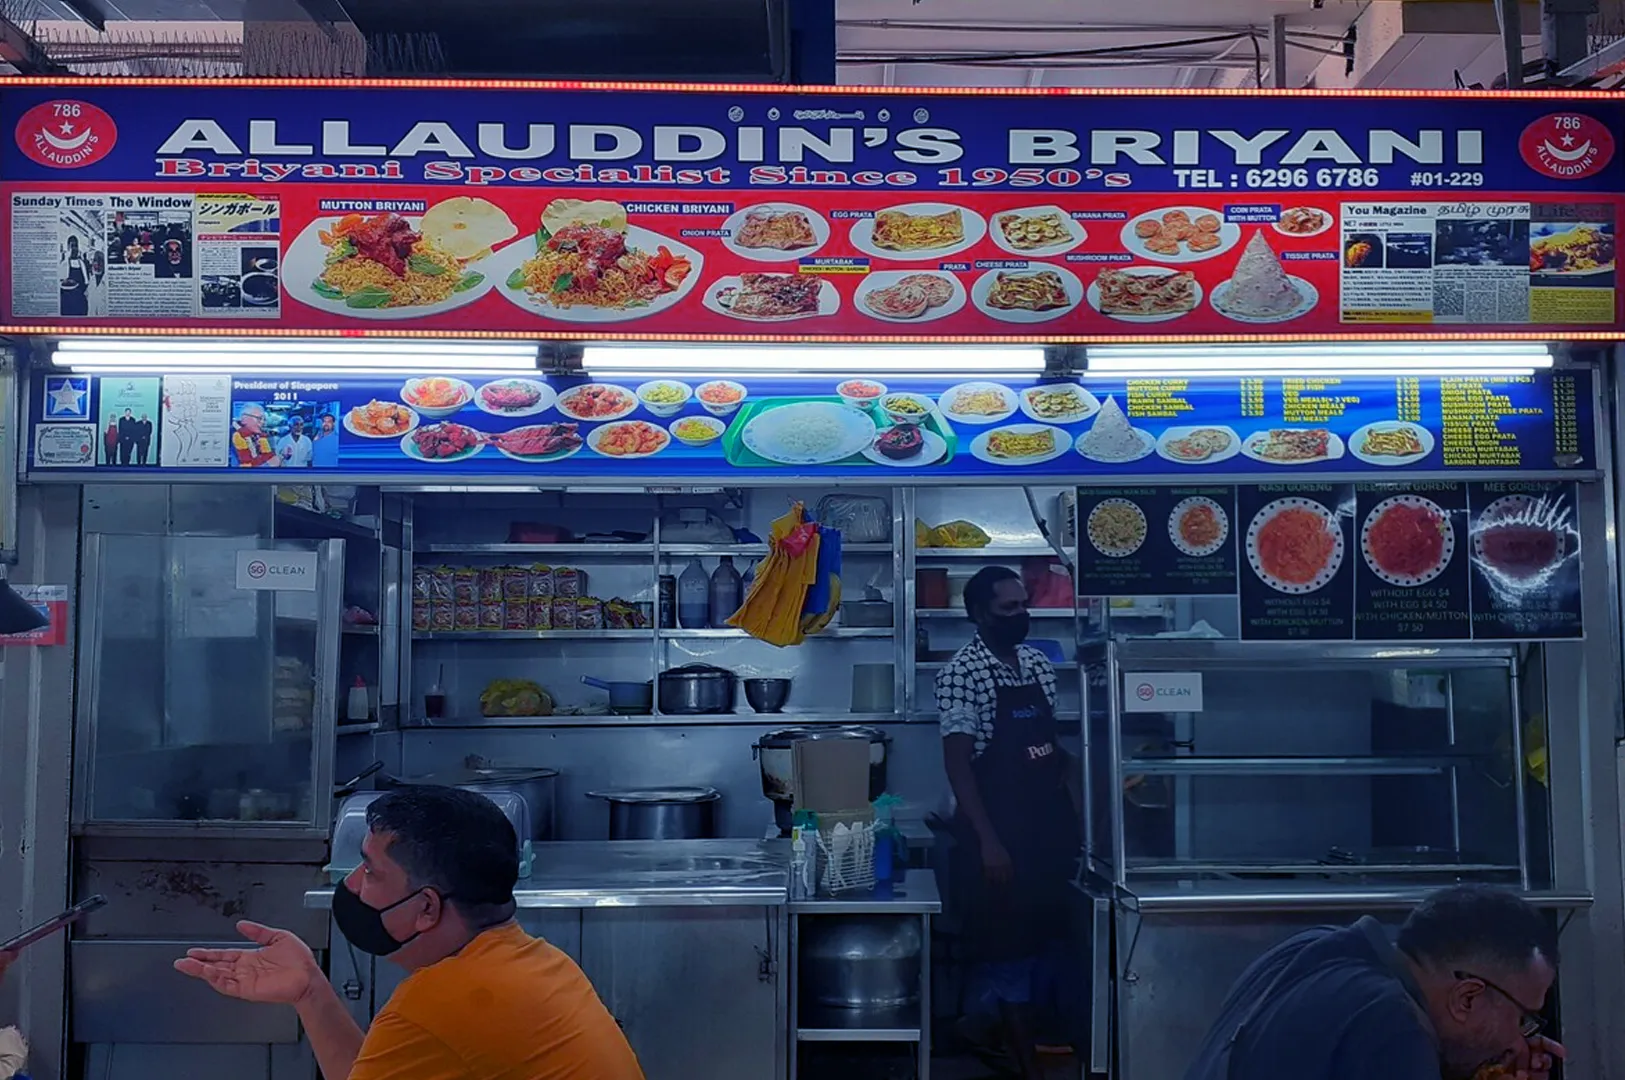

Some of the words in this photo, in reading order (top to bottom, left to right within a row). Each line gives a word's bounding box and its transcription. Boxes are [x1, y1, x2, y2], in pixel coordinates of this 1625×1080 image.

[53, 104, 81, 117] 786
[1554, 116, 1580, 130] 786
[156, 119, 964, 164] ALLAUDDIN'S
[1009, 129, 1482, 165] BRIYANI
[34, 132, 99, 164] ALLAUDDIN'S
[1536, 144, 1598, 176] ALLAUDDIN'S
[156, 158, 404, 182] Briyani
[424, 160, 731, 185] Specialist
[749, 165, 917, 186] Since
[938, 168, 1132, 187] 1950's
[1173, 169, 1223, 188] TEL
[1246, 169, 1308, 188] 6296
[1316, 168, 1379, 188] 6786
[1410, 172, 1484, 186] #01-229
[13, 196, 61, 209] Sunday
[64, 196, 104, 207] Times
[110, 196, 136, 208] The
[138, 196, 192, 208] Window
[321, 201, 373, 212] MUTTON
[375, 201, 425, 212] BRIYANI
[626, 203, 681, 214] CHICKEN
[682, 203, 730, 214] BRIYANI
[1347, 205, 1370, 217] You
[1372, 205, 1427, 217] Magazine
[1072, 212, 1100, 220] BANANA
[1101, 212, 1126, 220] PRATA
[682, 229, 705, 237] ONION
[706, 229, 730, 237] PRATA
[1108, 254, 1132, 262] PRATA
[234, 381, 278, 391] President
[280, 381, 288, 391] of
[291, 381, 338, 391] Singapore
[273, 392, 297, 400] 2011
[1484, 483, 1508, 492] MEE
[269, 565, 306, 575] CLEAN
[1370, 589, 1414, 597] WITHOUT
[1416, 589, 1436, 597] EGG
[1438, 589, 1450, 597] $4
[1373, 600, 1399, 609] WITH
[1400, 600, 1419, 609] EGG
[1156, 687, 1191, 697] CLEAN
